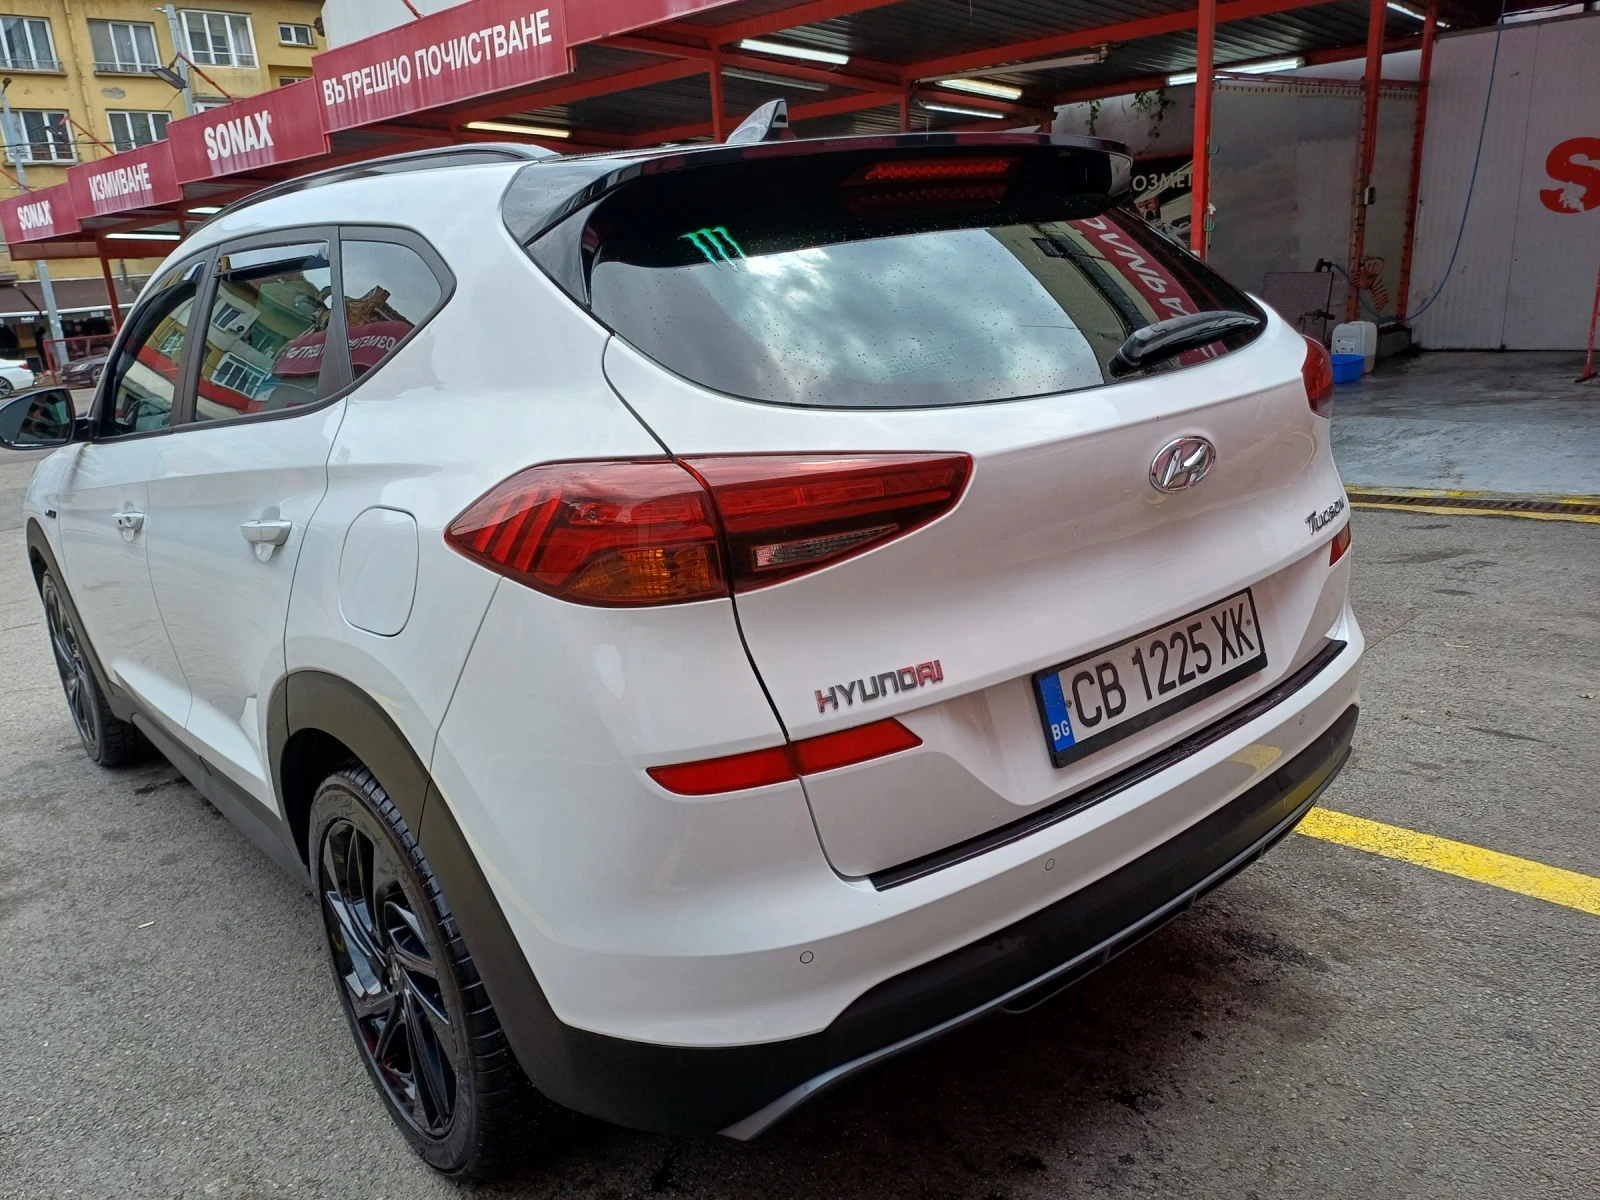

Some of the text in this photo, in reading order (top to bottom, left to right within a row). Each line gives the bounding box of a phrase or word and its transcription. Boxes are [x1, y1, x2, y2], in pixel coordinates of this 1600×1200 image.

[322, 8, 552, 106] ВЪТРЕШНО ПОЧИСТВАНЕ
[204, 110, 274, 161] SONAX
[88, 162, 152, 202] ИЗМИВАНЕ
[1130, 172, 1193, 192] ОЗМЕТ
[17, 200, 54, 231] SONAX
[1304, 496, 1345, 535] TUCSON
[1071, 602, 1255, 728] CB 1225 XK
[815, 659, 944, 713] HYUNDAI
[1050, 719, 1071, 742] BG
